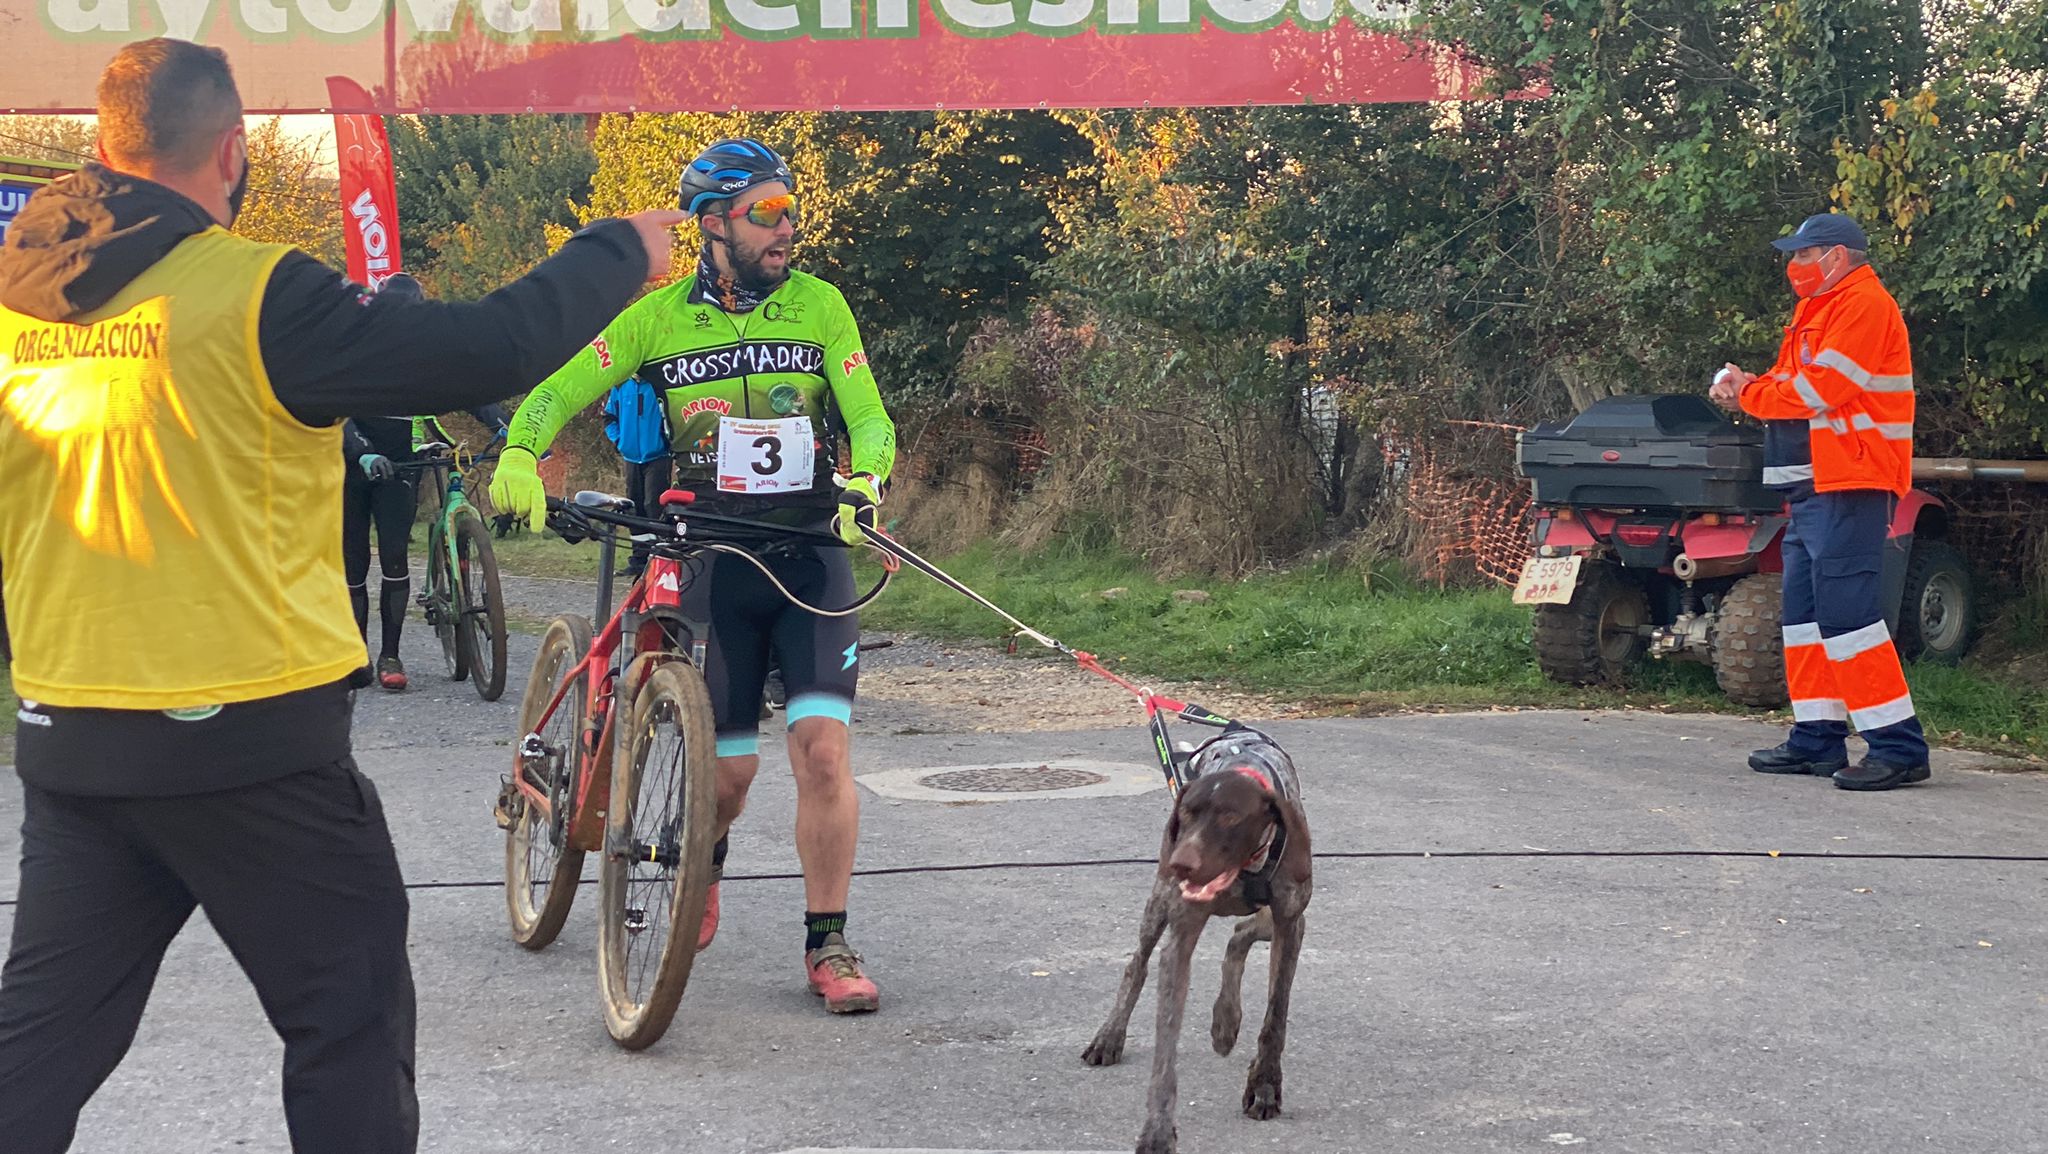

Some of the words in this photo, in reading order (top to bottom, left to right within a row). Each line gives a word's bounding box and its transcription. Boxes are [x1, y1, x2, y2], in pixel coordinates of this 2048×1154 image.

[14, 312, 161, 364] ORGANIZACIÓN
[682, 397, 732, 423] ARION
[751, 436, 783, 475] 3
[755, 479, 779, 489] ARION
[1526, 564, 1537, 579] E
[1540, 562, 1573, 578] 5979
